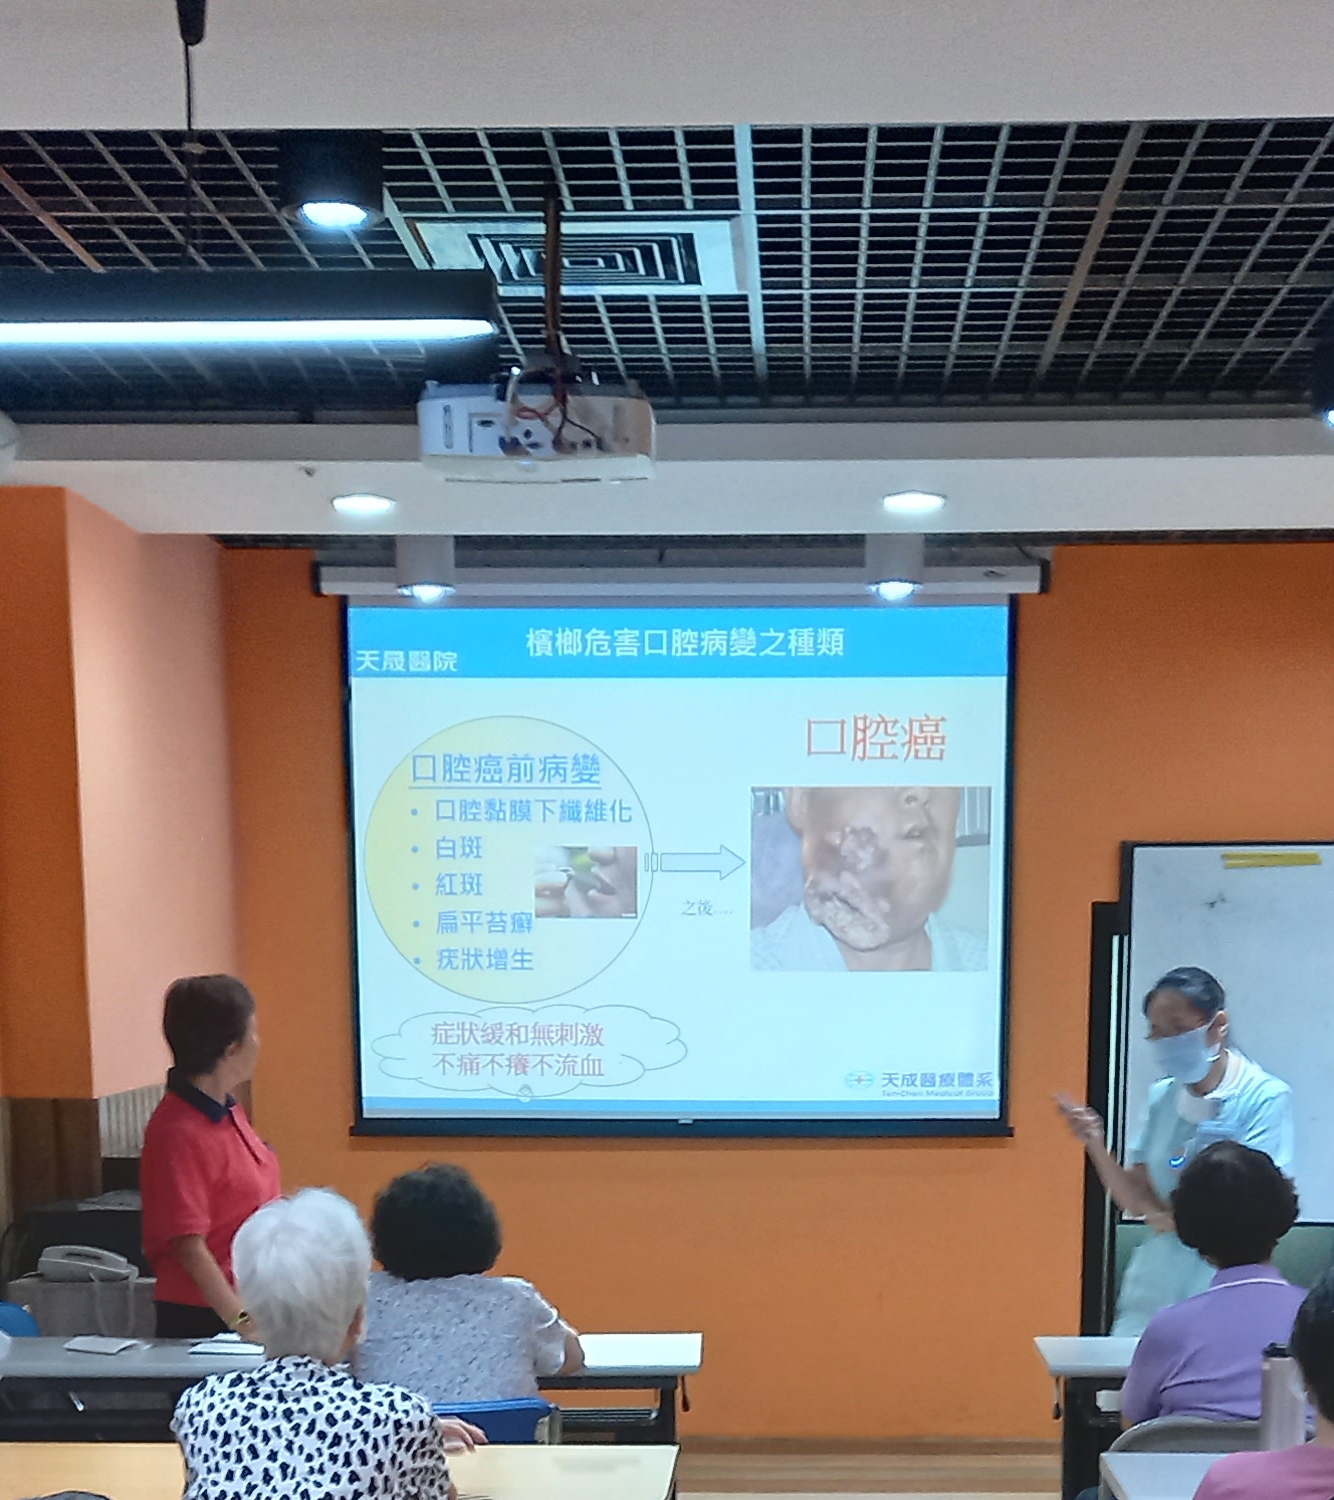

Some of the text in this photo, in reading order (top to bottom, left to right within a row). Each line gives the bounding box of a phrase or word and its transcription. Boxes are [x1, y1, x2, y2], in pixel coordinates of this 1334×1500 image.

[526, 626, 845, 658] 檳榔危害口腔病變之種類
[355, 649, 458, 673] 天晟醫院
[807, 713, 947, 762] 口腔癌
[412, 753, 601, 785] 口腔癌前病變
[435, 798, 633, 824] 口腔黏膜下纖維化
[435, 835, 483, 860] 白斑
[435, 872, 483, 896] 紅斑
[436, 910, 533, 935] 扁平苔癬
[436, 947, 534, 971] 疣狀增生
[431, 1021, 605, 1046] 症狀緩和無刺激
[431, 1053, 605, 1077] 不痛不癢不流血
[881, 1071, 993, 1088] 天成醫療體系
